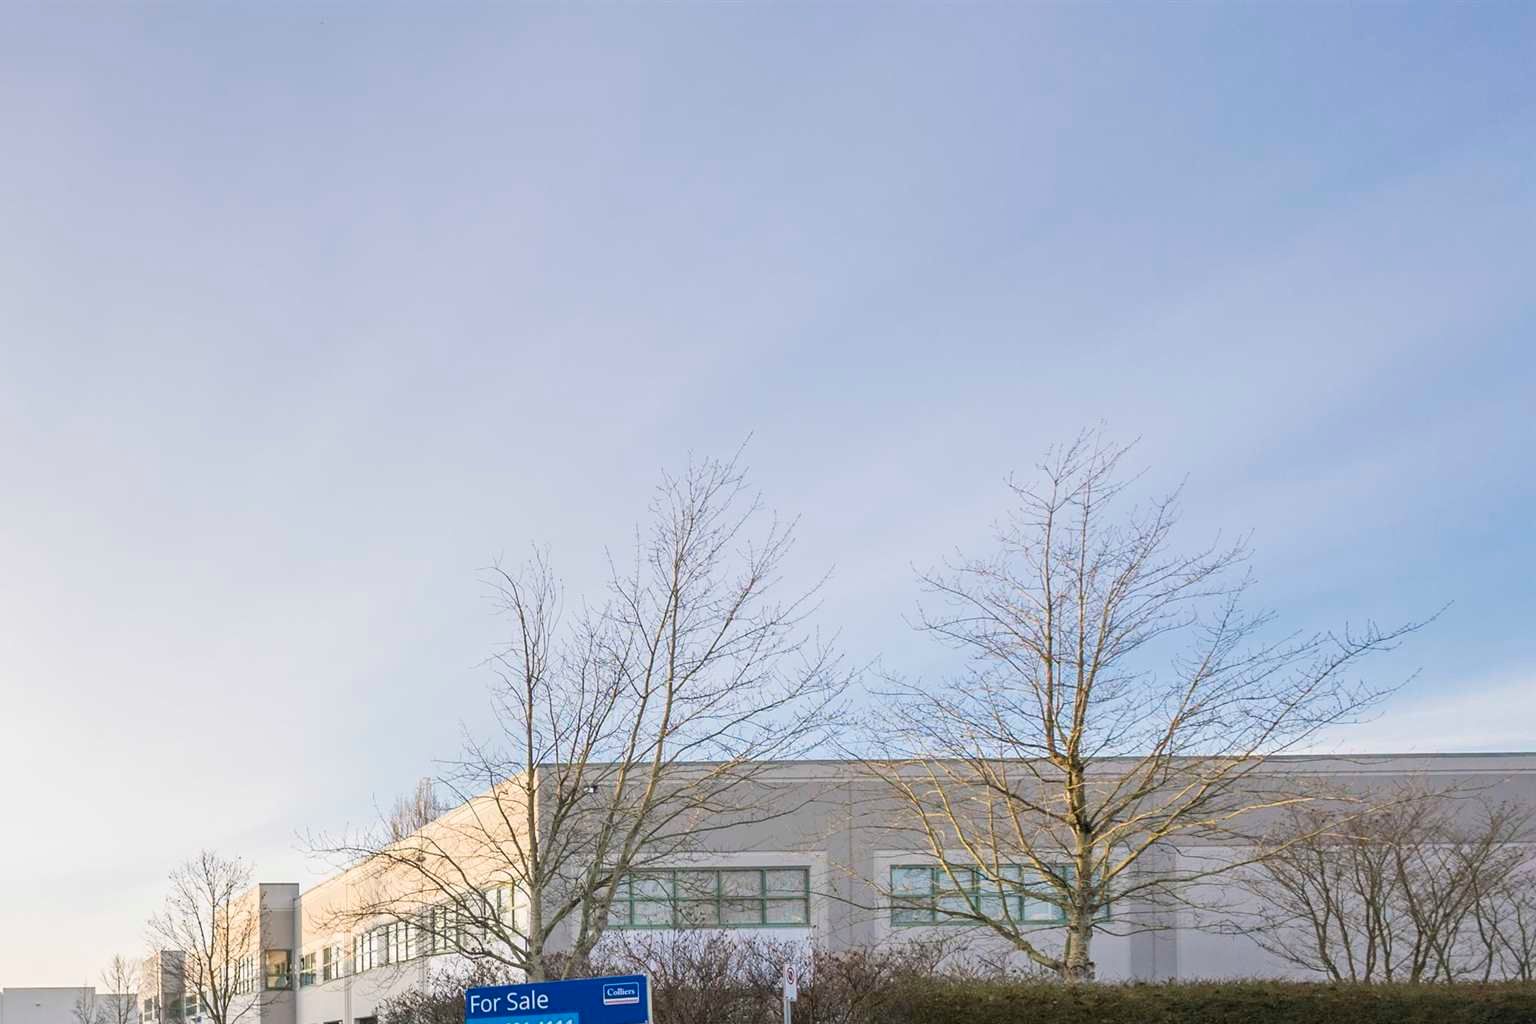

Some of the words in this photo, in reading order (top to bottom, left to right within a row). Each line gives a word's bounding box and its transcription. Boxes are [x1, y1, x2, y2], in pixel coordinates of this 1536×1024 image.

[606, 987, 636, 997] Colliers
[470, 994, 501, 1013] For
[507, 990, 549, 1011] Sale
